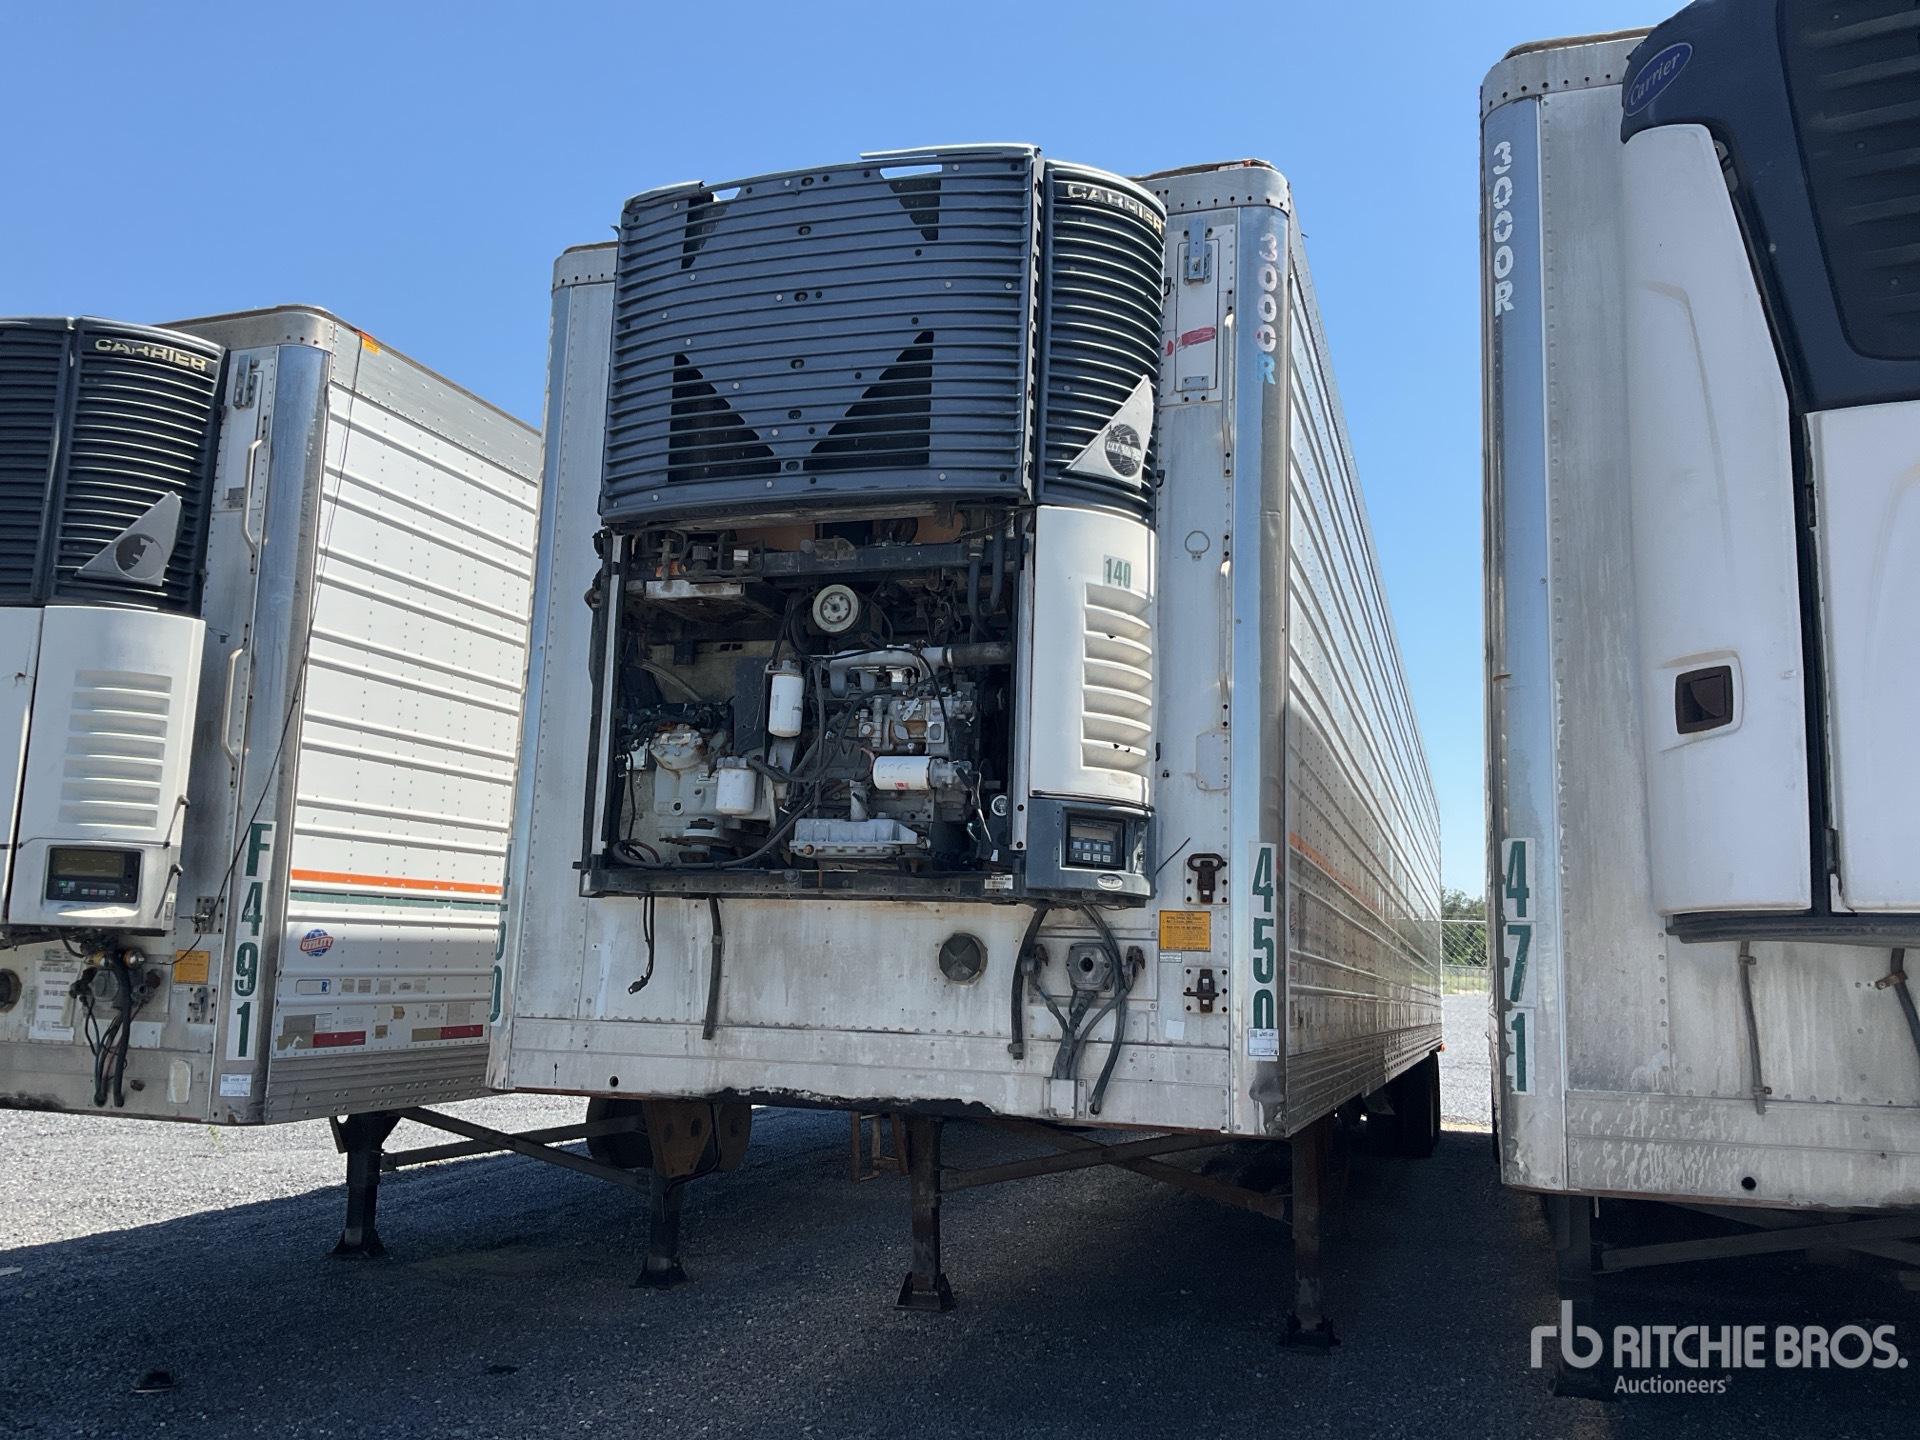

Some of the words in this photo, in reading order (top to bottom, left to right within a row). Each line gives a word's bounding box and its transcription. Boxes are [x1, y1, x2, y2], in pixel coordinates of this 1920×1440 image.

[1628, 51, 1681, 108] Carrier
[1067, 183, 1162, 236] CARRIER
[1105, 558, 1131, 589] 140
[234, 822, 273, 1058] F491
[301, 936, 333, 952] UTILITY
[1252, 847, 1275, 1029] 450
[1505, 840, 1532, 1092] 471
